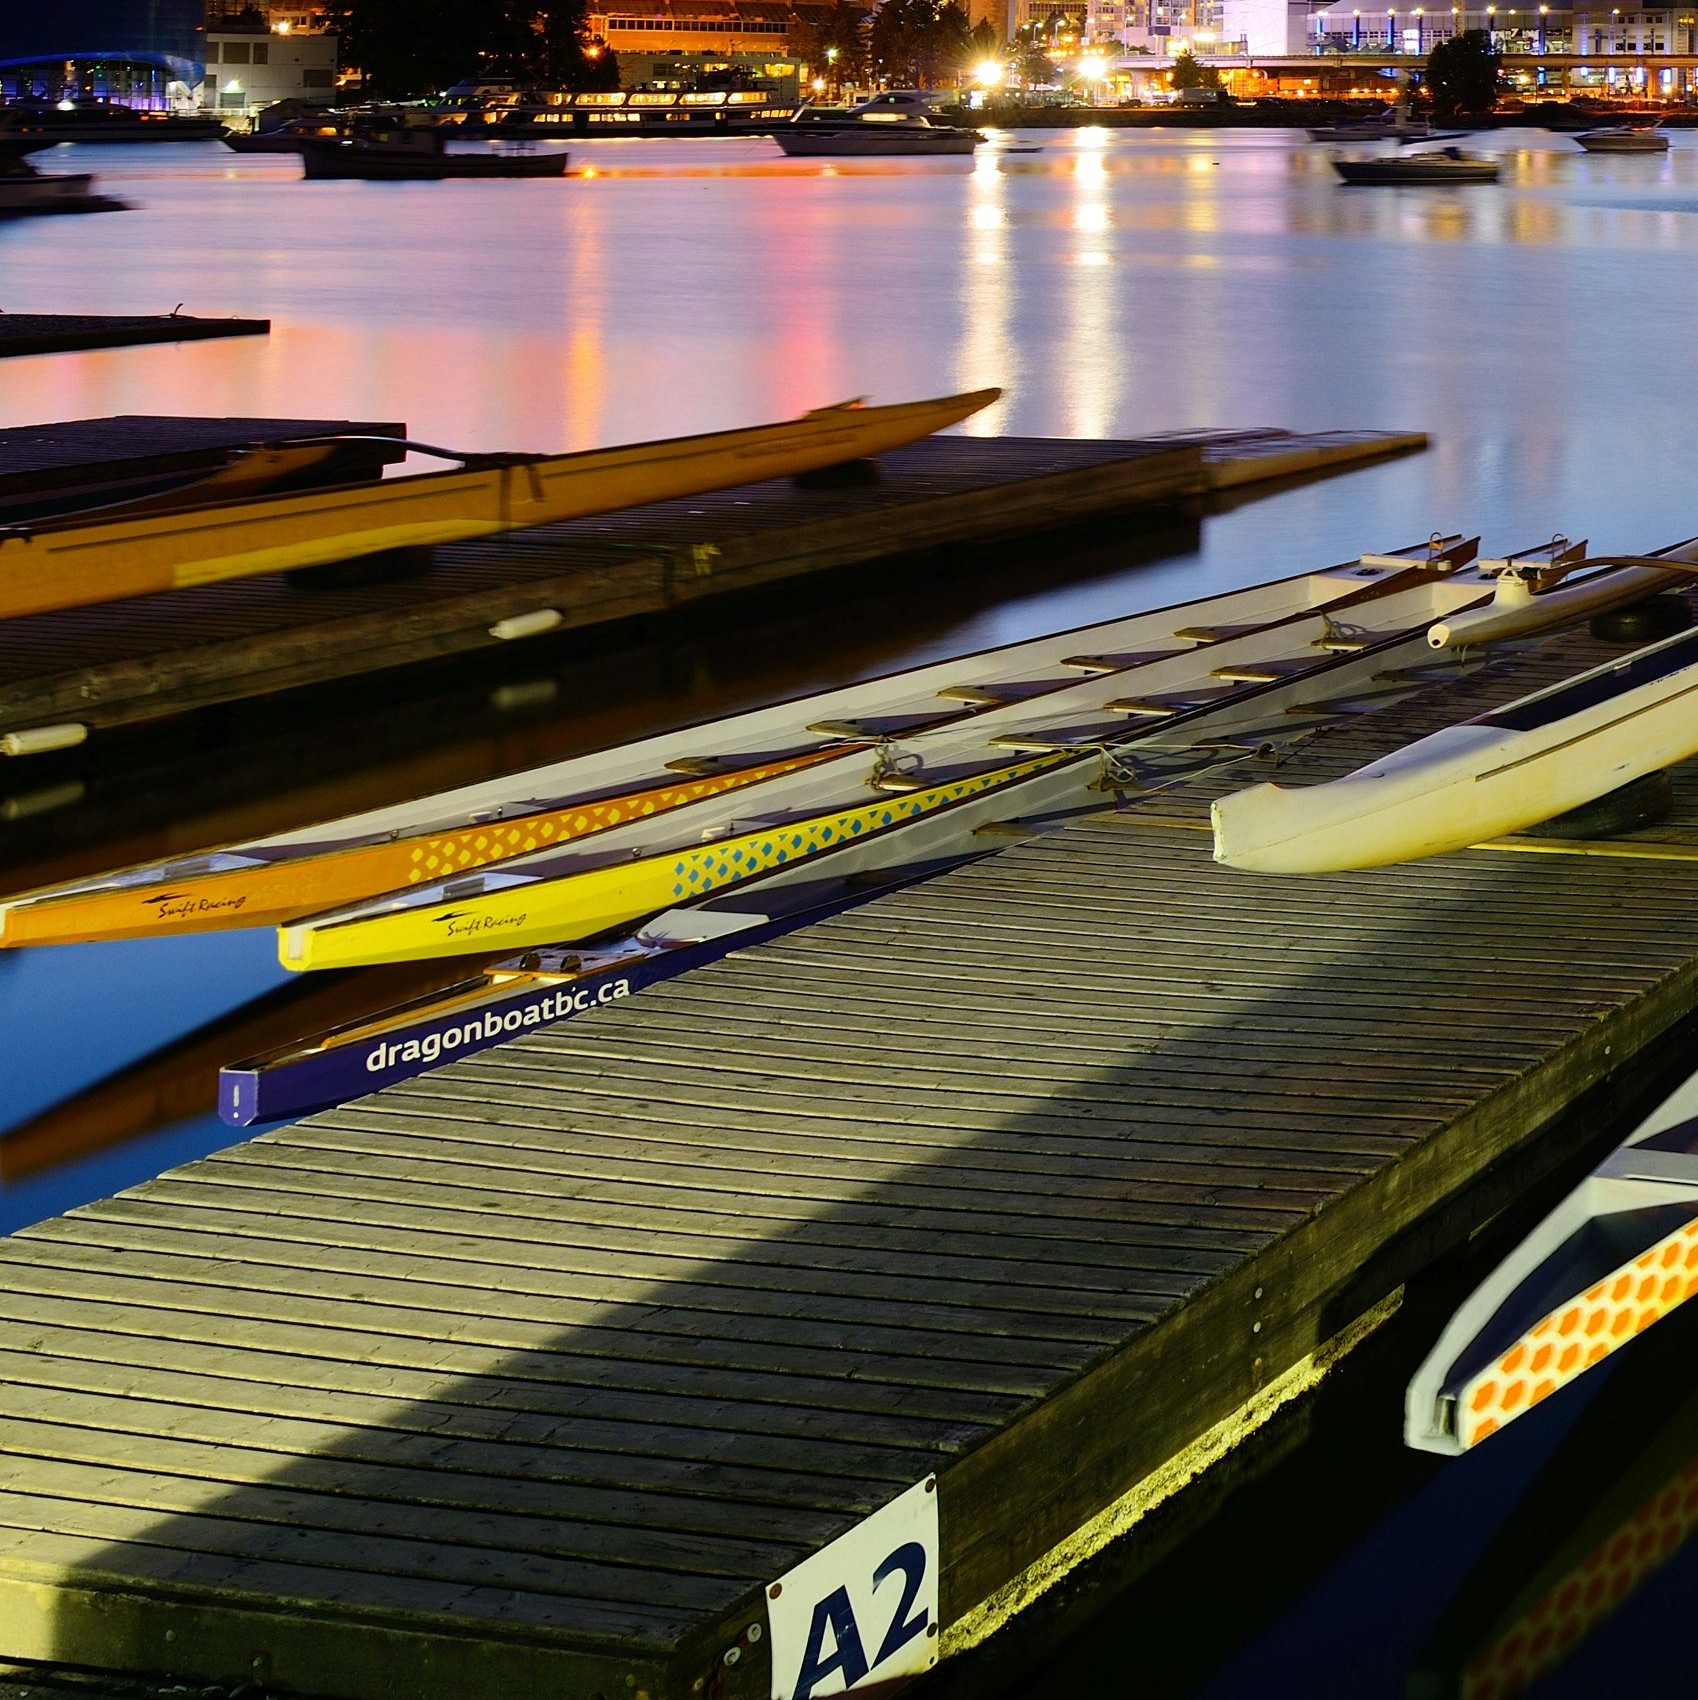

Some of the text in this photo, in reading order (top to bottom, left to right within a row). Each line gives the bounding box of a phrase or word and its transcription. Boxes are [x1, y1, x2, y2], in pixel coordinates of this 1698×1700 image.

[158, 896, 247, 918] Swift Racing
[447, 913, 527, 937] Swift Racing
[366, 978, 631, 1072] dragonboatbc.ca
[791, 1542, 929, 1700] A2
